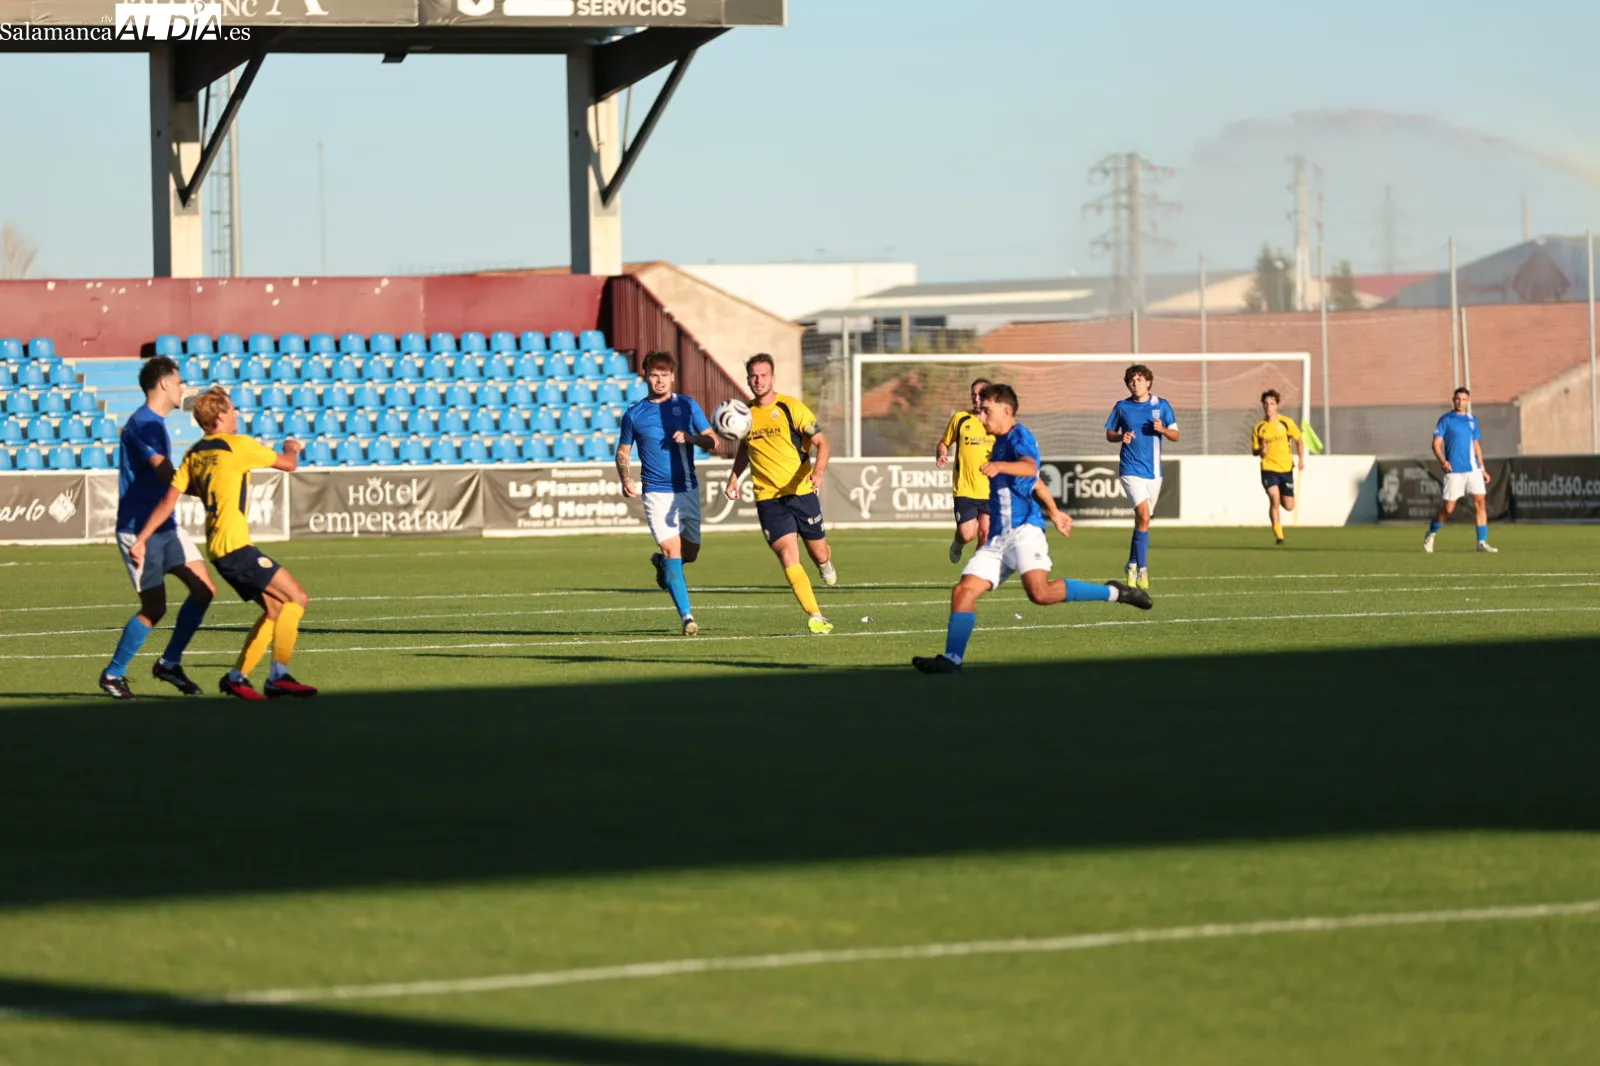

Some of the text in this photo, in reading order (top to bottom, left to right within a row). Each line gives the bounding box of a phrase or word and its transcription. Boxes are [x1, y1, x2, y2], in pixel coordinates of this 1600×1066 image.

[577, 0, 687, 16] SERVICIOS
[508, 481, 532, 498] La
[0, 498, 46, 522] arlo
[528, 501, 555, 518] de
